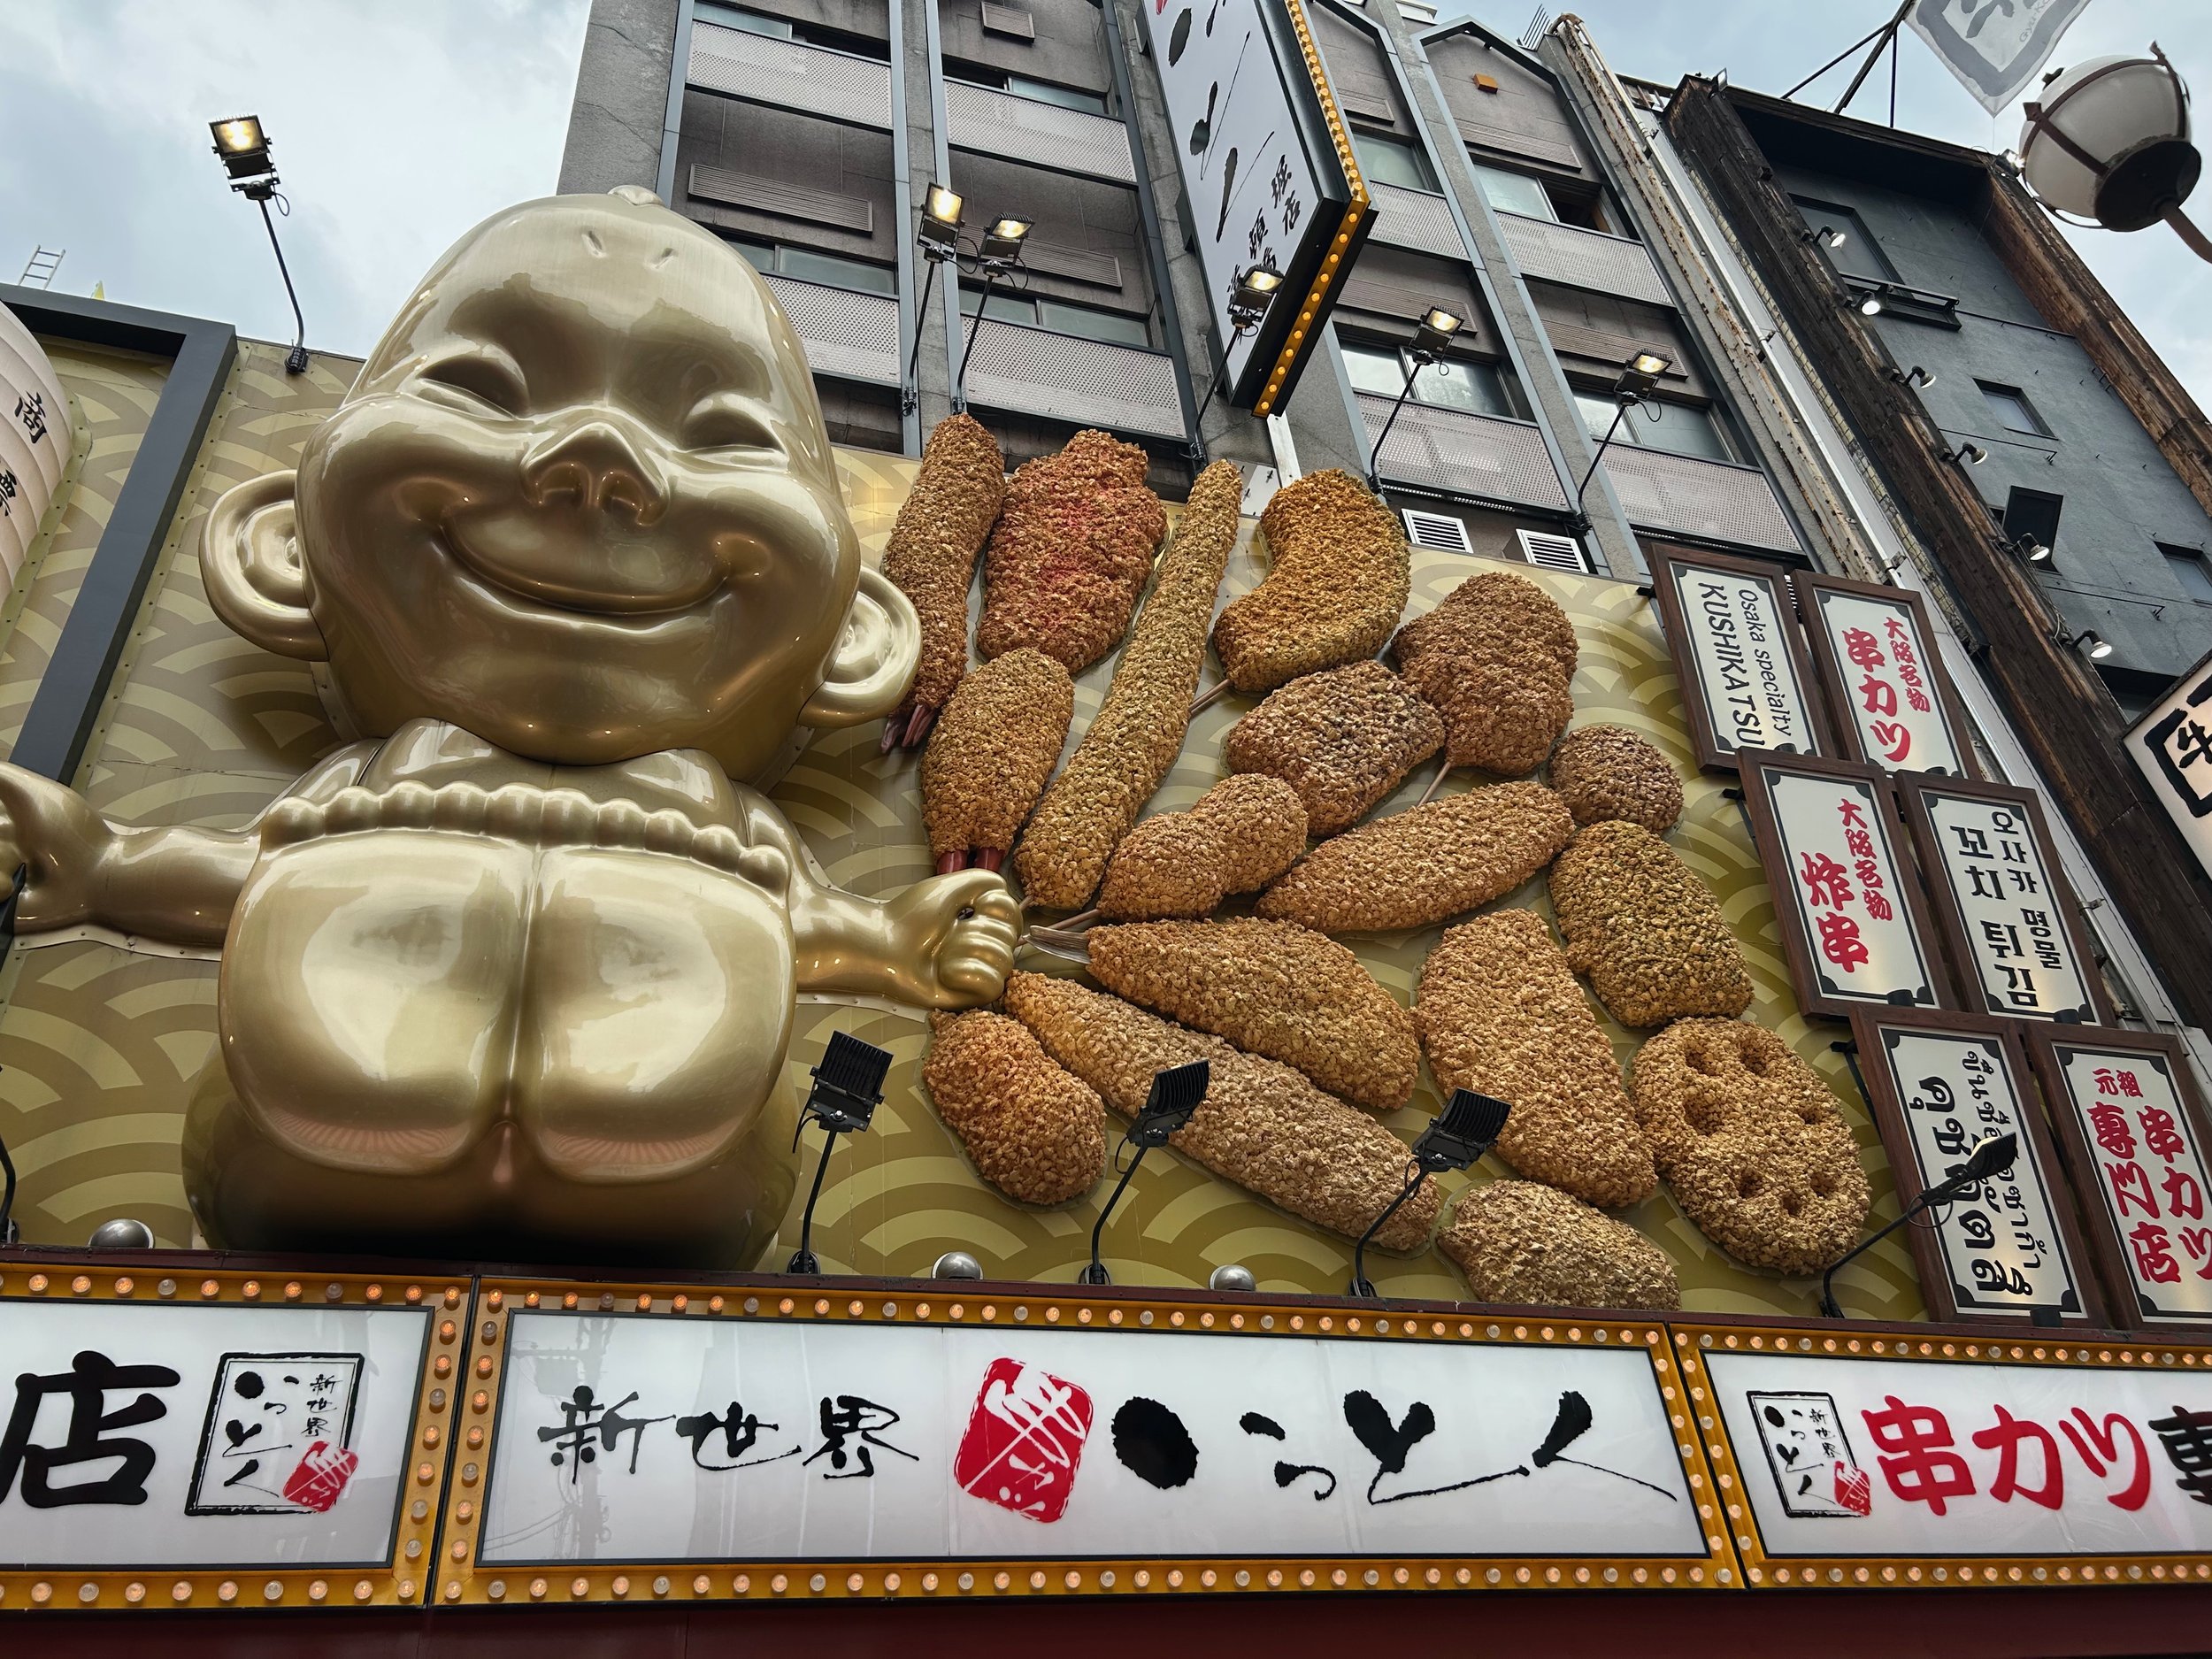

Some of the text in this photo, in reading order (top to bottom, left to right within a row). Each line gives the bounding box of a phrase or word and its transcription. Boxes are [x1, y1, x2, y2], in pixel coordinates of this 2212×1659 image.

[1738, 588, 1792, 736] Osaka specialty
[1841, 626, 1911, 763] 串カツ
[1883, 617, 1931, 713] 大阪名物
[1800, 851, 1870, 973] 炸串
[1837, 798, 1893, 921] 大阪名物
[1948, 825, 2039, 1008] 꼬치 튀김
[1991, 810, 2063, 970] 오사카 명물
[2092, 1068, 2144, 1098] 元祖
[2136, 1104, 2212, 1280] 串カツ
[0, 1350, 181, 1509] 店
[301, 1373, 342, 1438] 新世界
[537, 1385, 920, 1485] 新世界
[1809, 1408, 1841, 1459] 新世界
